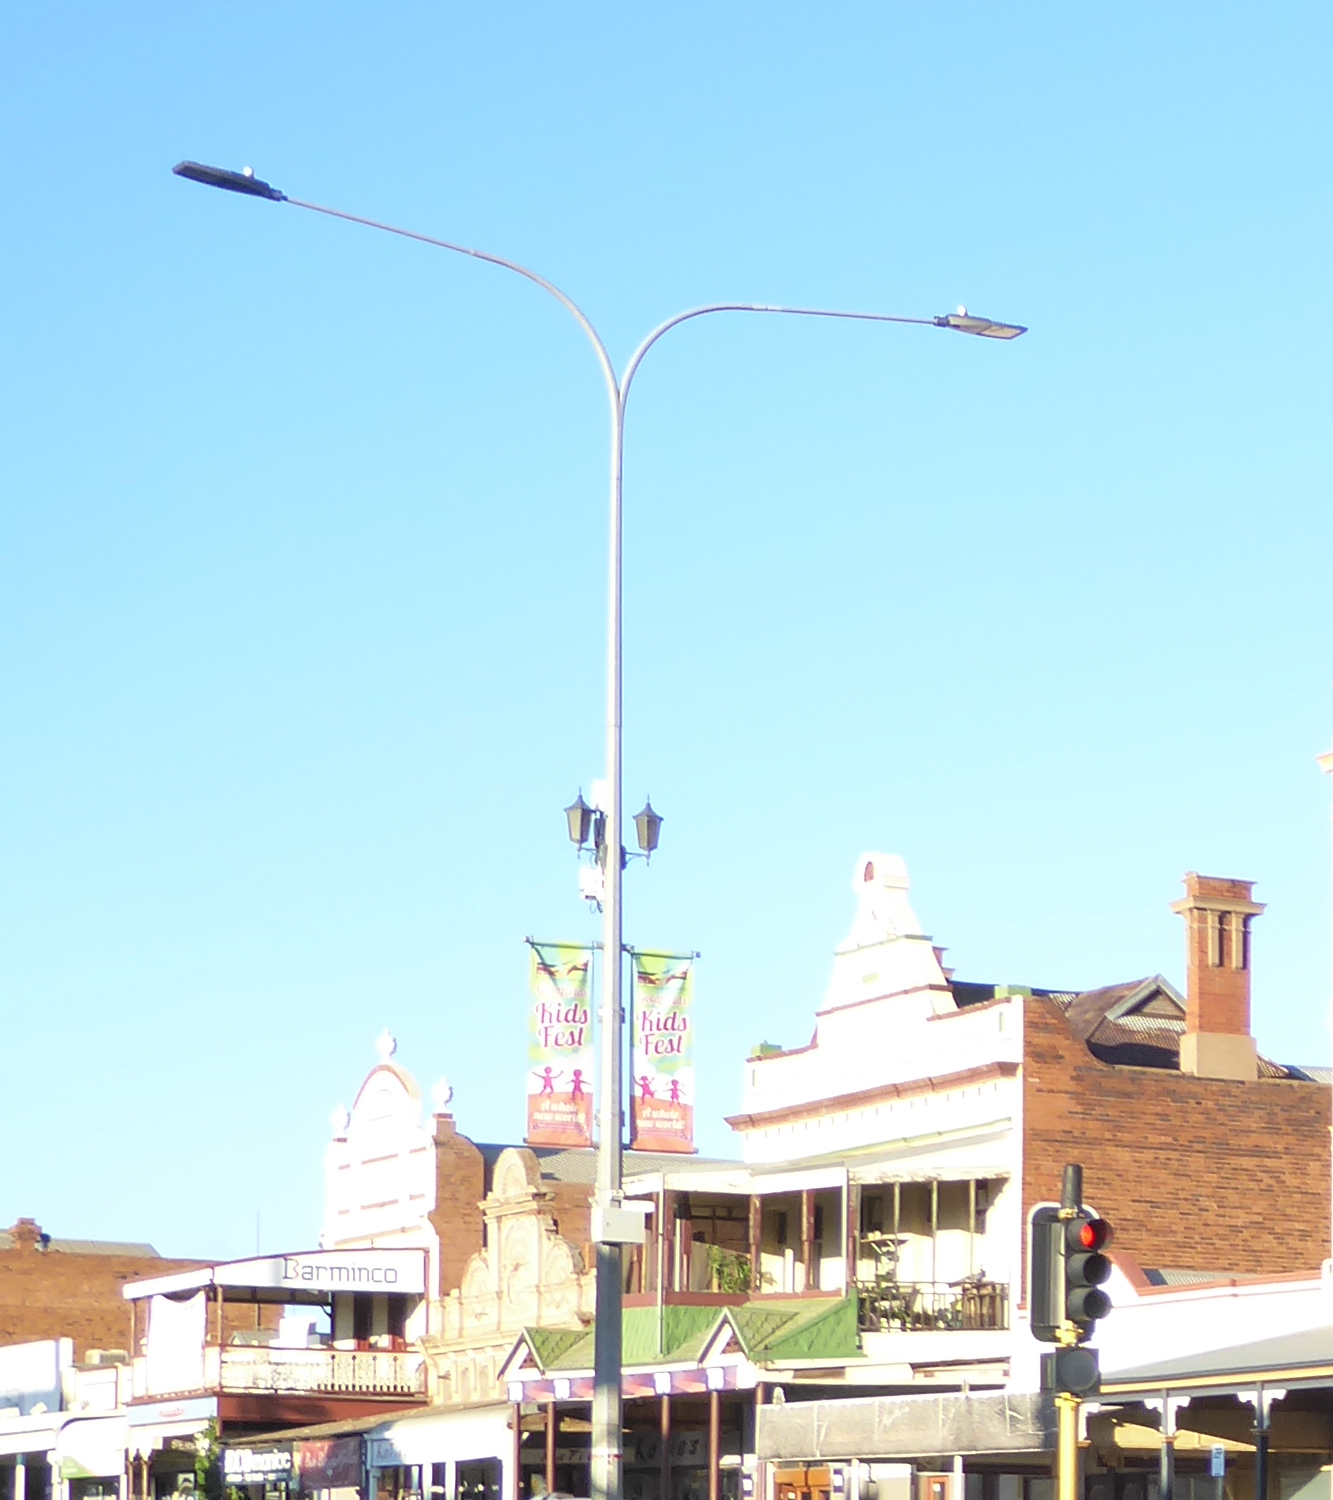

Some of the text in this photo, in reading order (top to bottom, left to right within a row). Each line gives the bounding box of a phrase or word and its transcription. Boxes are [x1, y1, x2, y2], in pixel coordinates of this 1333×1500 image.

[535, 1002, 588, 1024] Kids
[636, 1010, 688, 1032] Kids
[538, 1025, 584, 1048] Fest
[639, 1034, 683, 1056] Fest
[282, 1256, 398, 1284] Barminco
